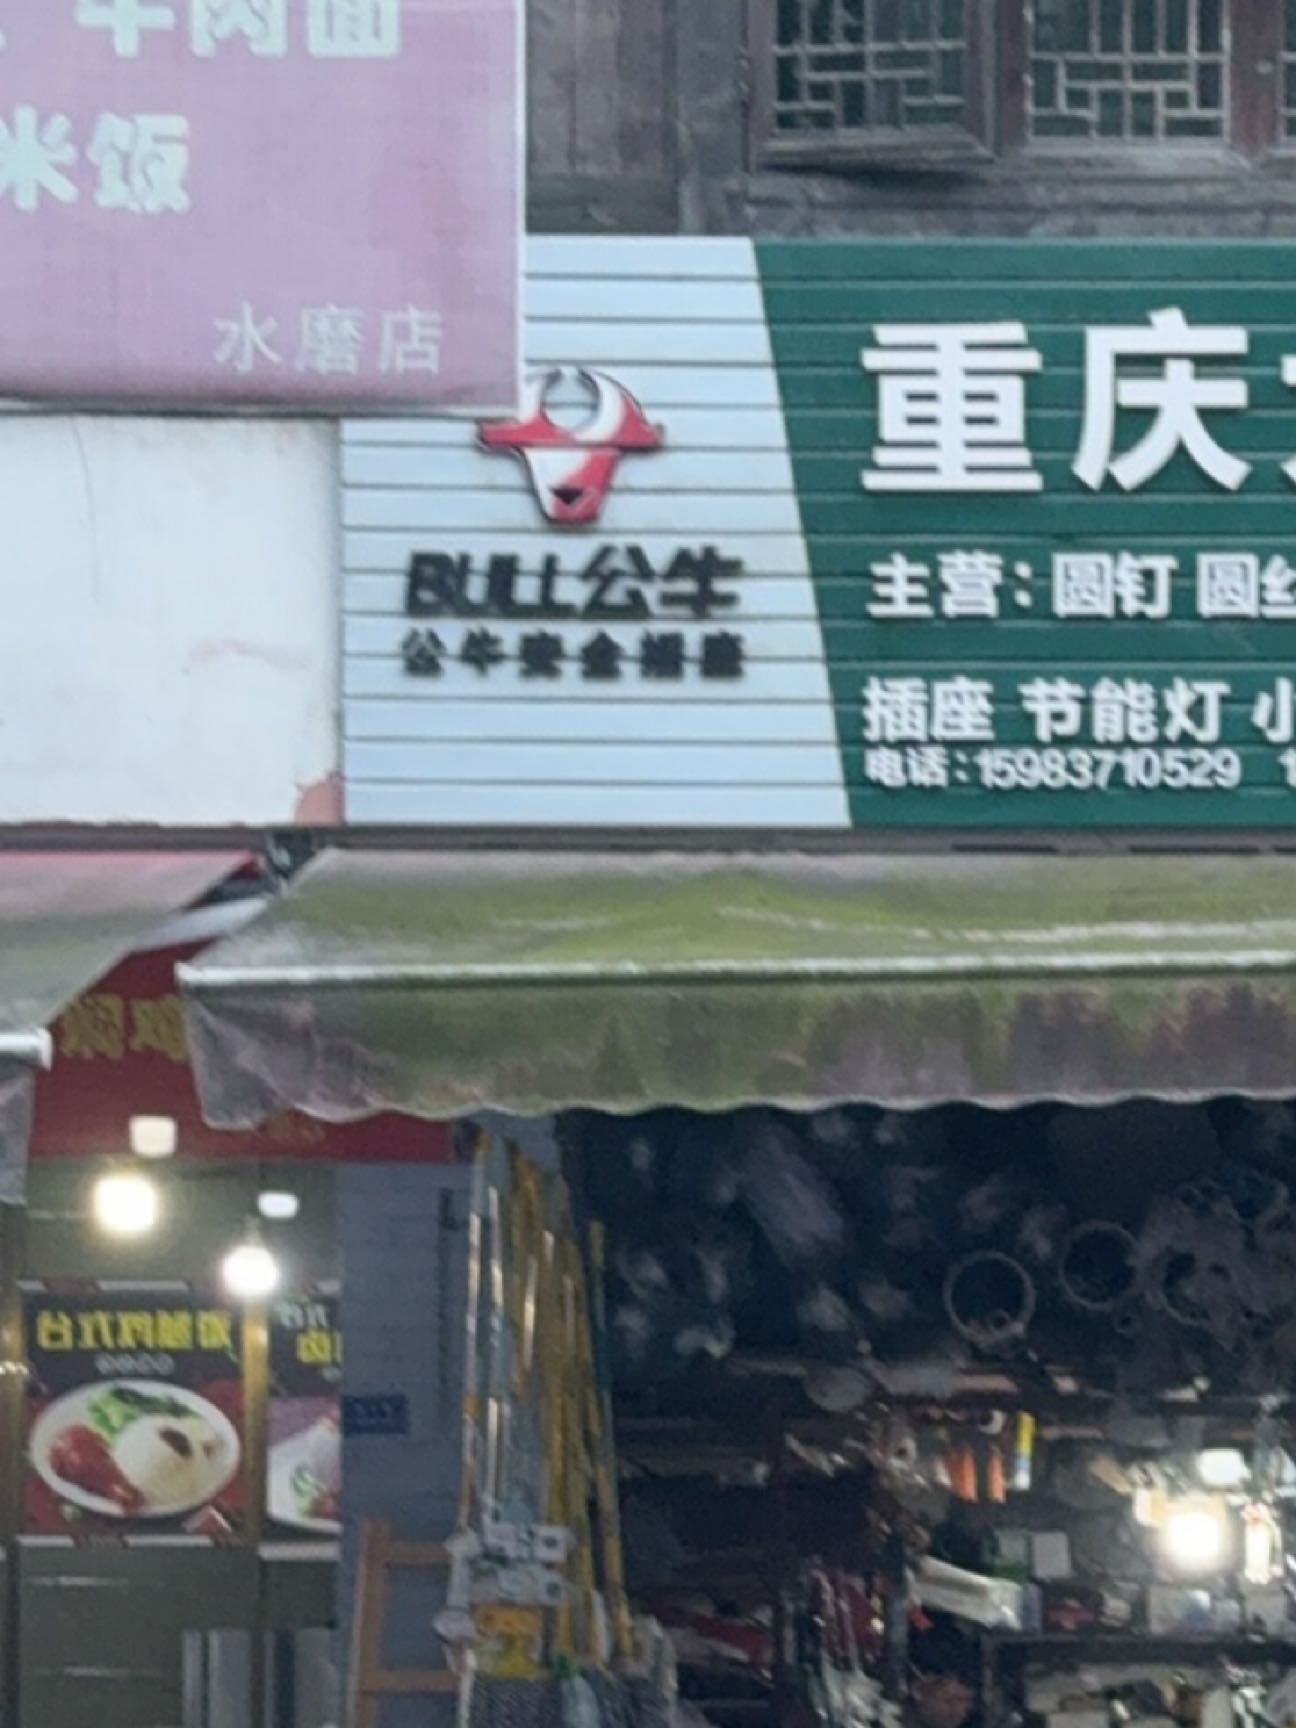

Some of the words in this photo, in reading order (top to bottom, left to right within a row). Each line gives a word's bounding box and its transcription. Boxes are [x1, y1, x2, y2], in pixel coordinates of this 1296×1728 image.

[0, 105, 191, 214] 米饭
[213, 302, 443, 375] 水磨店
[1052, 550, 1178, 620] 圆钉
[862, 676, 996, 744] 插座
[1016, 676, 1232, 744] 节能灯
